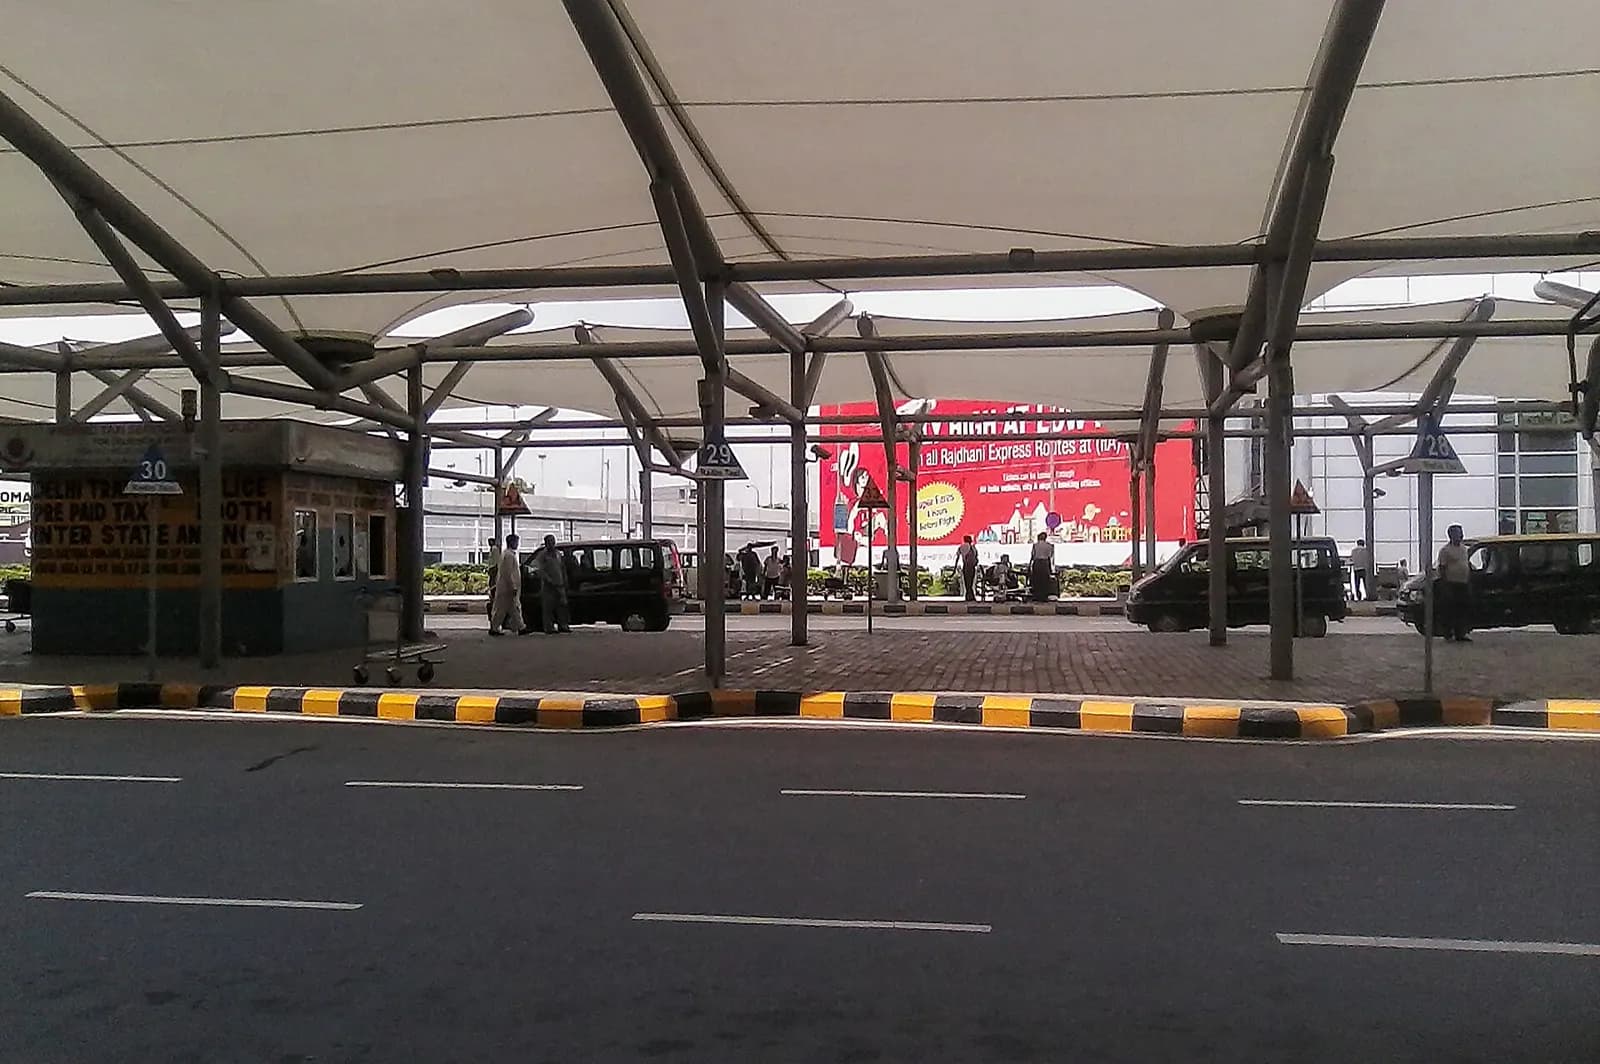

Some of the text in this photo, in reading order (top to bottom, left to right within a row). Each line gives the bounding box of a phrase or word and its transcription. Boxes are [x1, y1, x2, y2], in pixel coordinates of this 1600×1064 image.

[706, 443, 731, 464] 29
[926, 448, 937, 466] all
[941, 445, 986, 467] Rajdhani
[988, 442, 1031, 465] Express
[1079, 439, 1092, 454] at
[141, 460, 166, 480] 30
[34, 502, 64, 522] PRE
[69, 502, 106, 522] PAID
[101, 524, 168, 545] STATE
